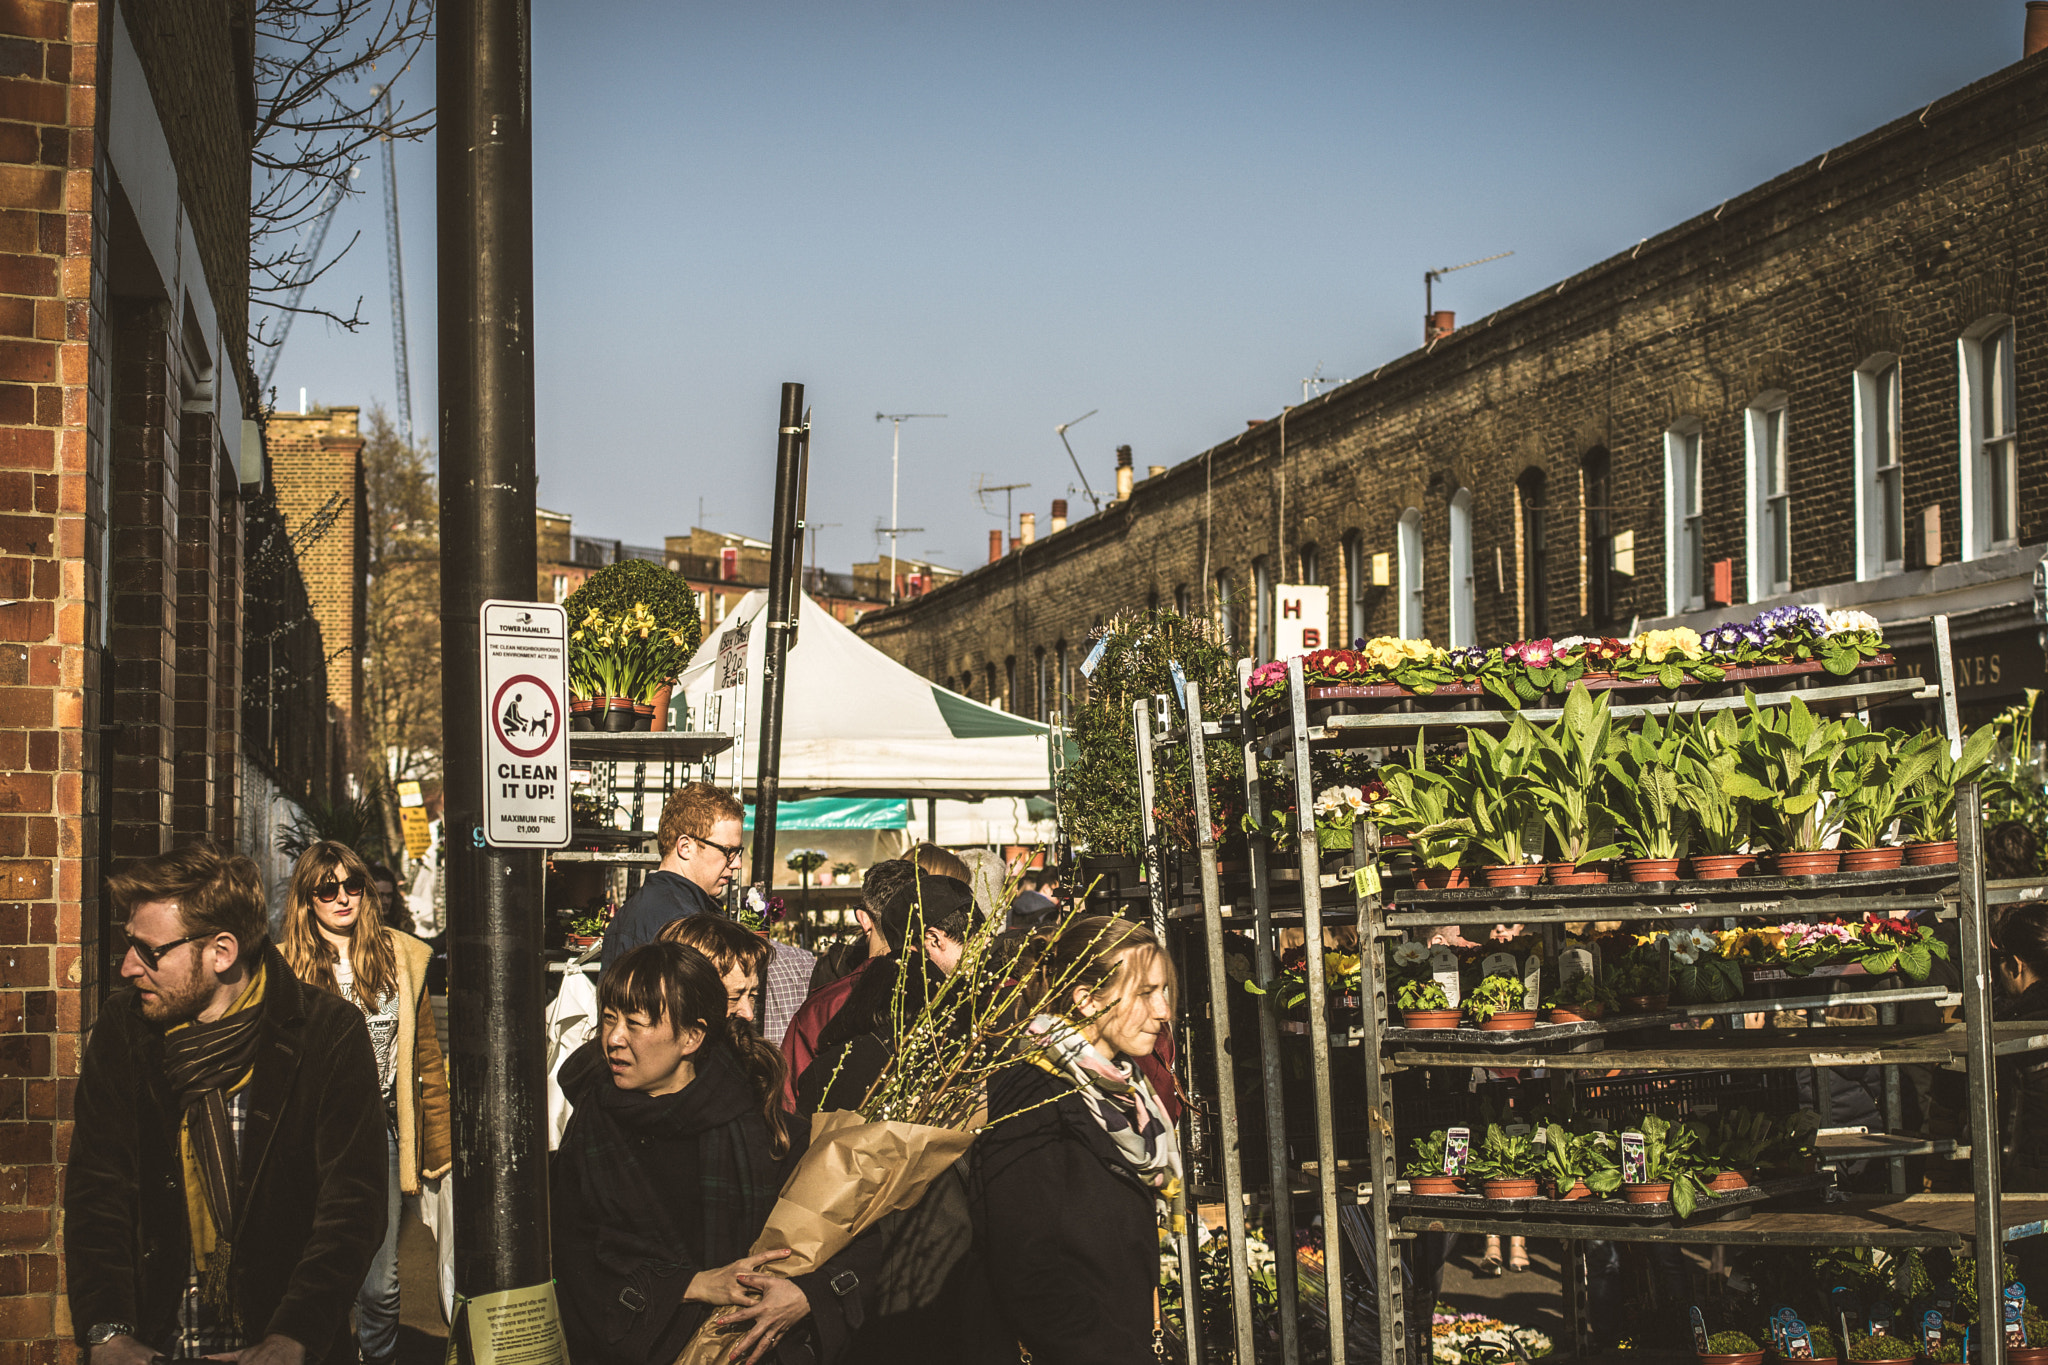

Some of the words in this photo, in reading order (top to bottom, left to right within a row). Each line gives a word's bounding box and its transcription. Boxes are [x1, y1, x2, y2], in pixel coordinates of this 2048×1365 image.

[1283, 598, 1301, 619] H
[499, 624, 521, 632] TOWER
[522, 626, 551, 634] HAMLETS
[1303, 628, 1321, 648] B
[516, 645, 561, 653] NEIGHBOURHOODS
[1958, 654, 2001, 688] NES
[497, 763, 558, 781] CLEAN
[502, 783, 519, 799] IT
[525, 783, 555, 800] UP!
[500, 814, 537, 823] MAXIMUM
[538, 815, 556, 824] FINE
[516, 825, 541, 834] £1,000
